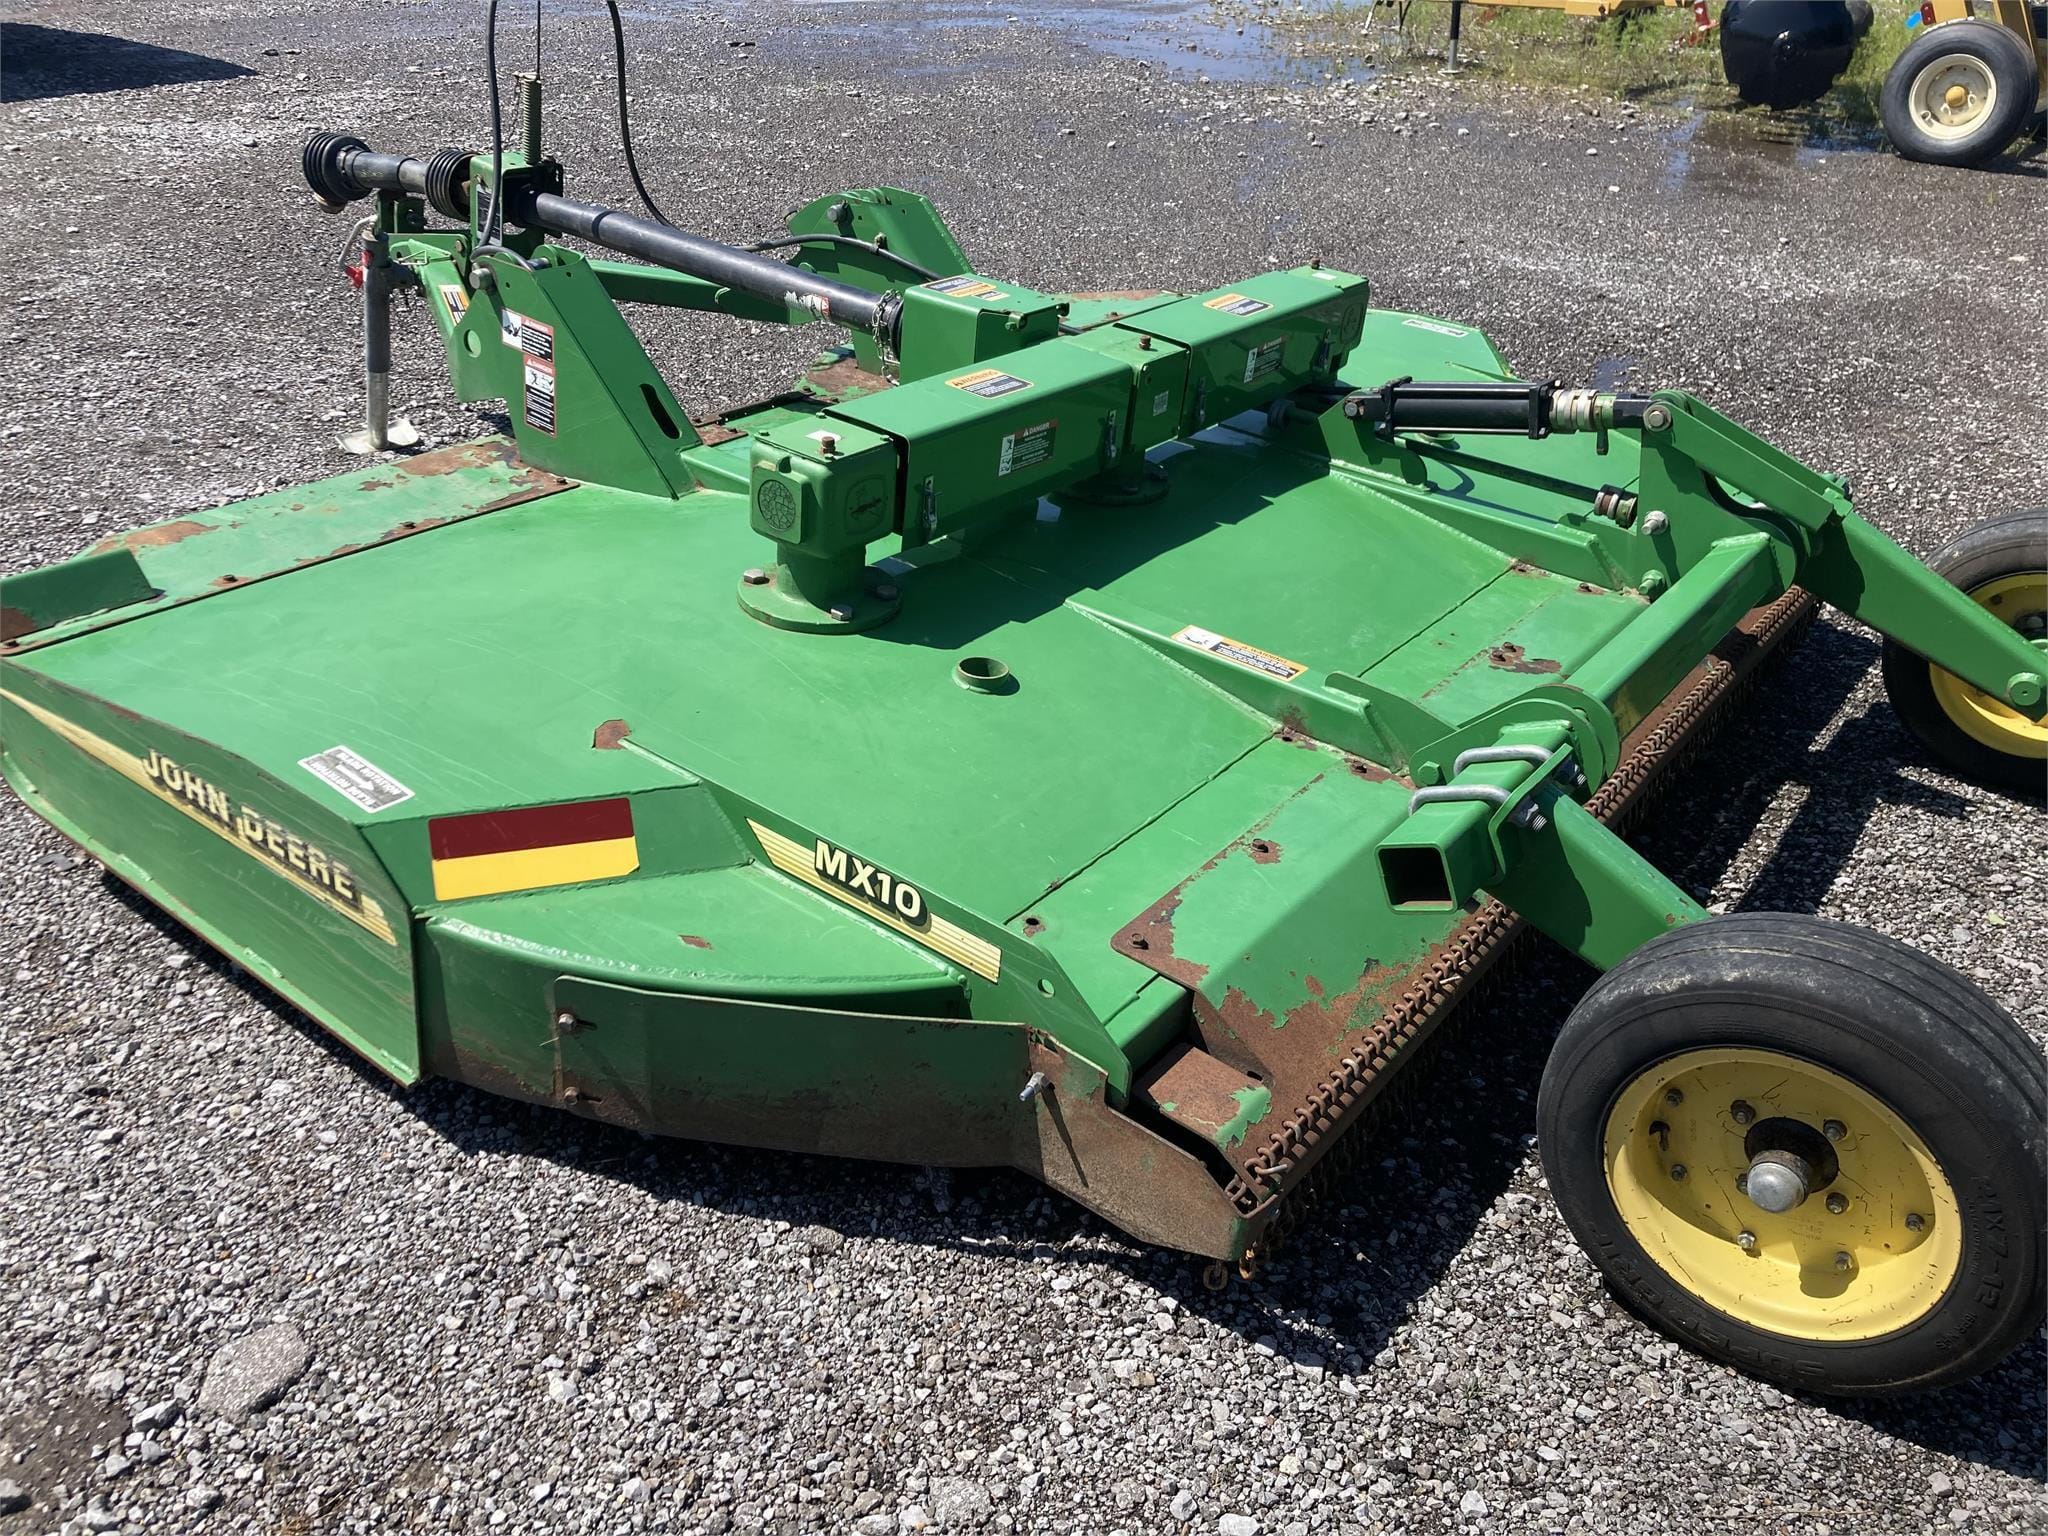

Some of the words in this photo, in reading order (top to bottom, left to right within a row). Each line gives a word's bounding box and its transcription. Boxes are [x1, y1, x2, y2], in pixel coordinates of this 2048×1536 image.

[1029, 421, 1050, 434] DANGER
[142, 748, 230, 823] JOHN
[236, 804, 359, 899] DEERE
[815, 838, 924, 922] MX10
